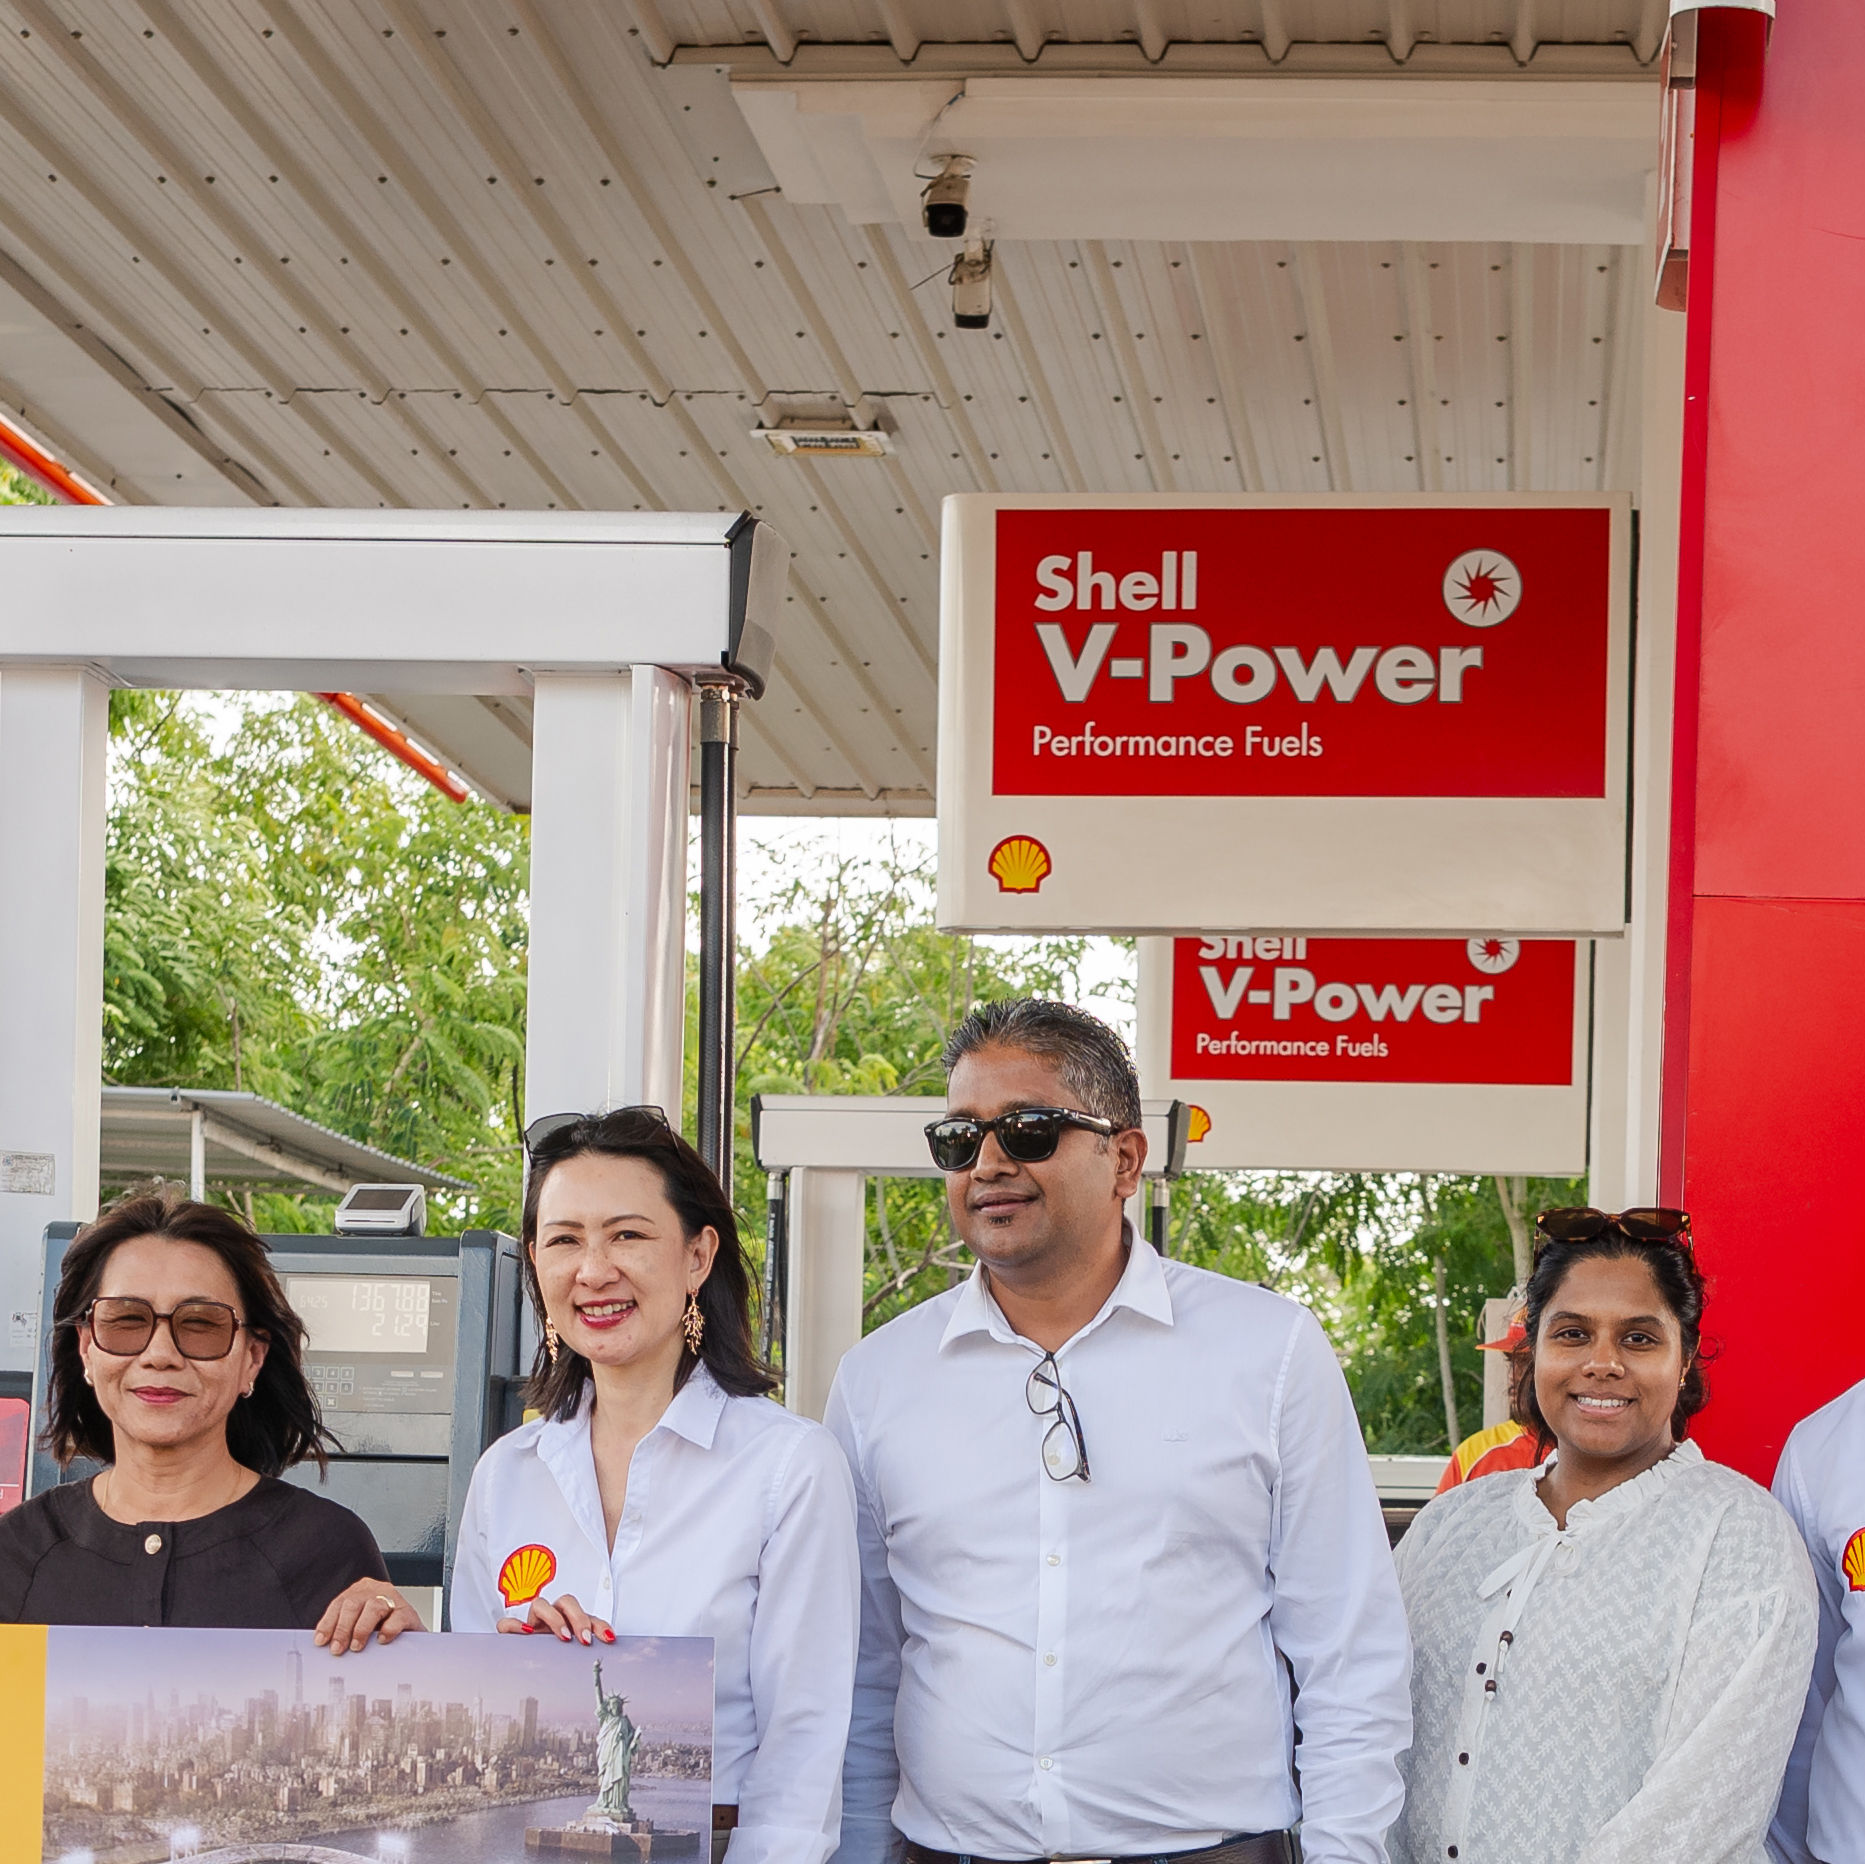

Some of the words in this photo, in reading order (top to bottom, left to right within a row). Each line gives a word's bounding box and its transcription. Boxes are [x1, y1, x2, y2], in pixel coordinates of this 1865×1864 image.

[1034, 551, 1198, 610] Shell
[1034, 622, 1484, 704] V-Power
[1032, 723, 1234, 757] Performance
[1245, 724, 1323, 758] Fuels
[1198, 966, 1494, 1023] V-Power
[1196, 1032, 1330, 1058] Performance
[1336, 1034, 1389, 1058] Fuels
[372, 1313, 428, 1337] 21.29
